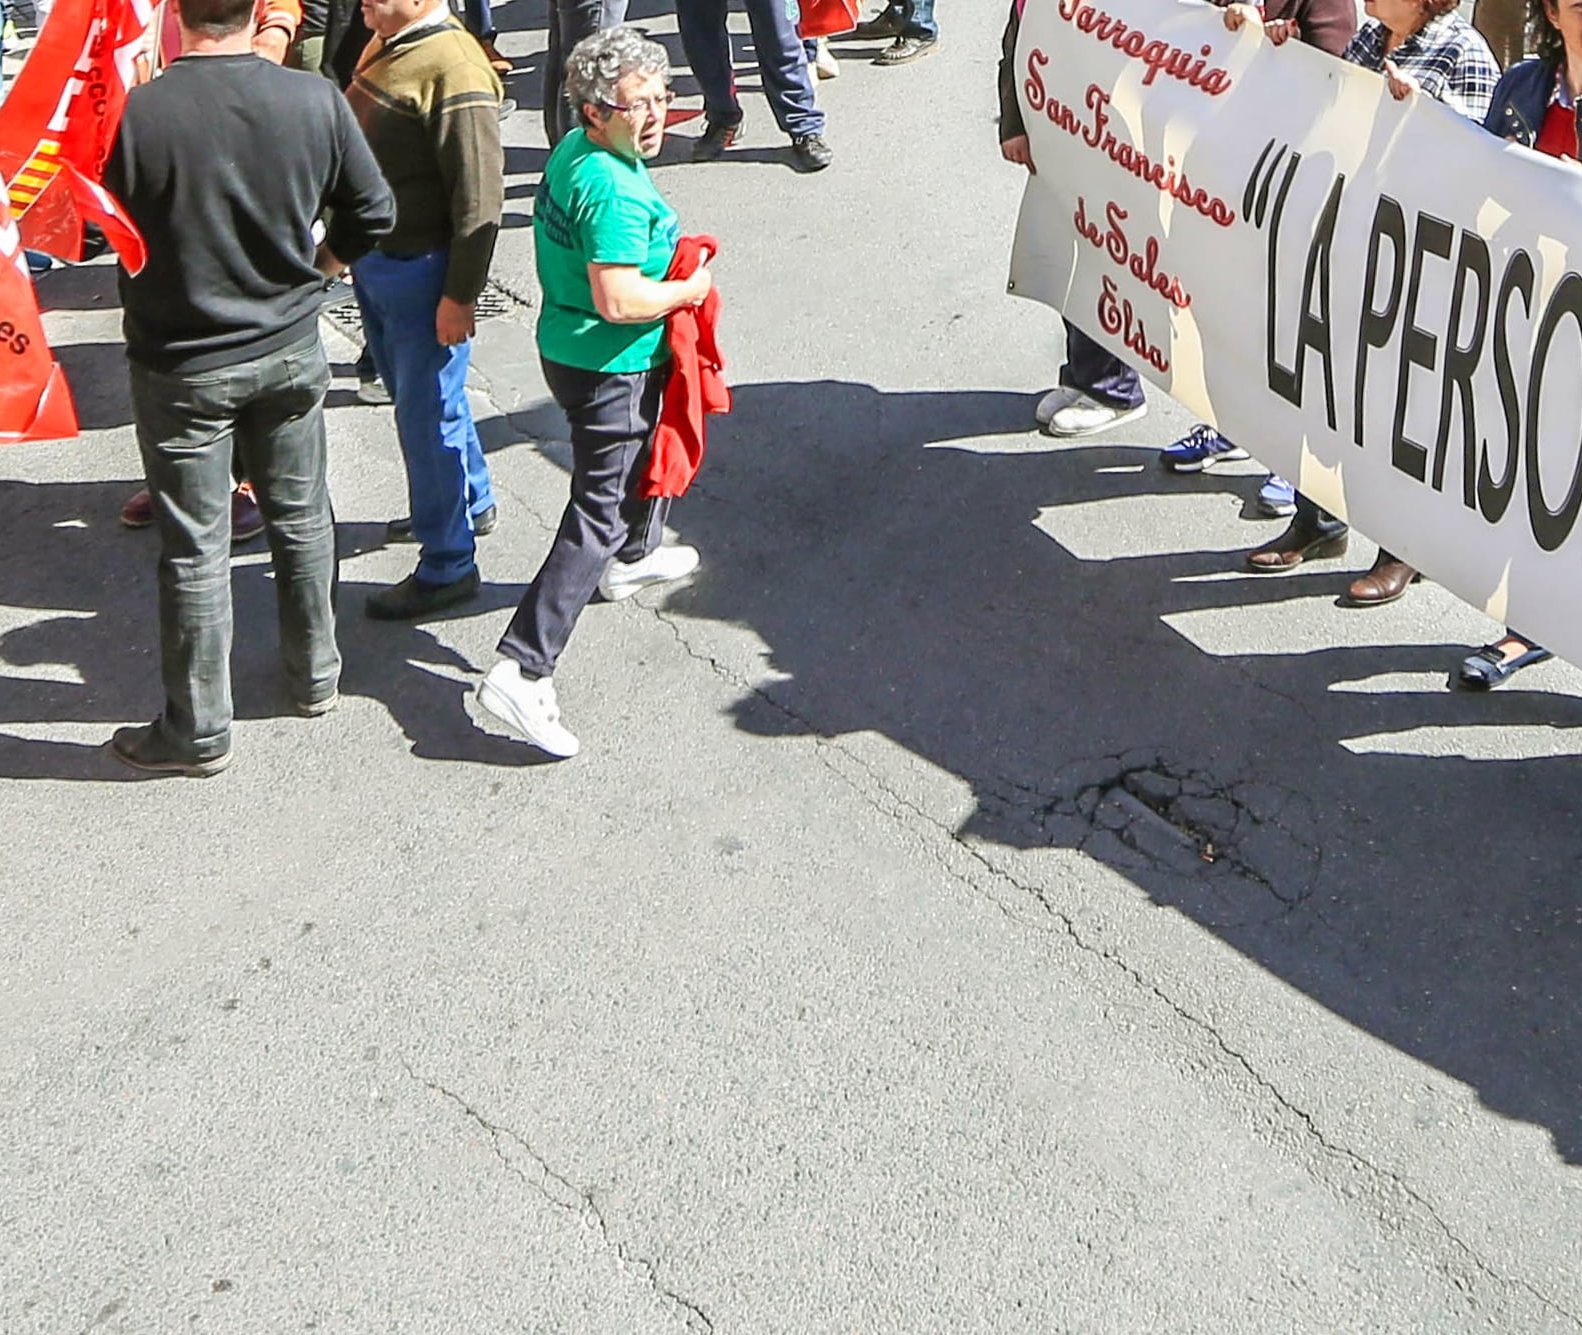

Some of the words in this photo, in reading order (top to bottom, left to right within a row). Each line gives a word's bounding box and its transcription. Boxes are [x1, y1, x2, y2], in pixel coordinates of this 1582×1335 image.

[1023, 48, 1081, 137] San
[1082, 84, 1235, 227] Francisco
[1073, 196, 1106, 250] de
[1104, 201, 1193, 310] Sales
[1097, 275, 1170, 374] Elda
